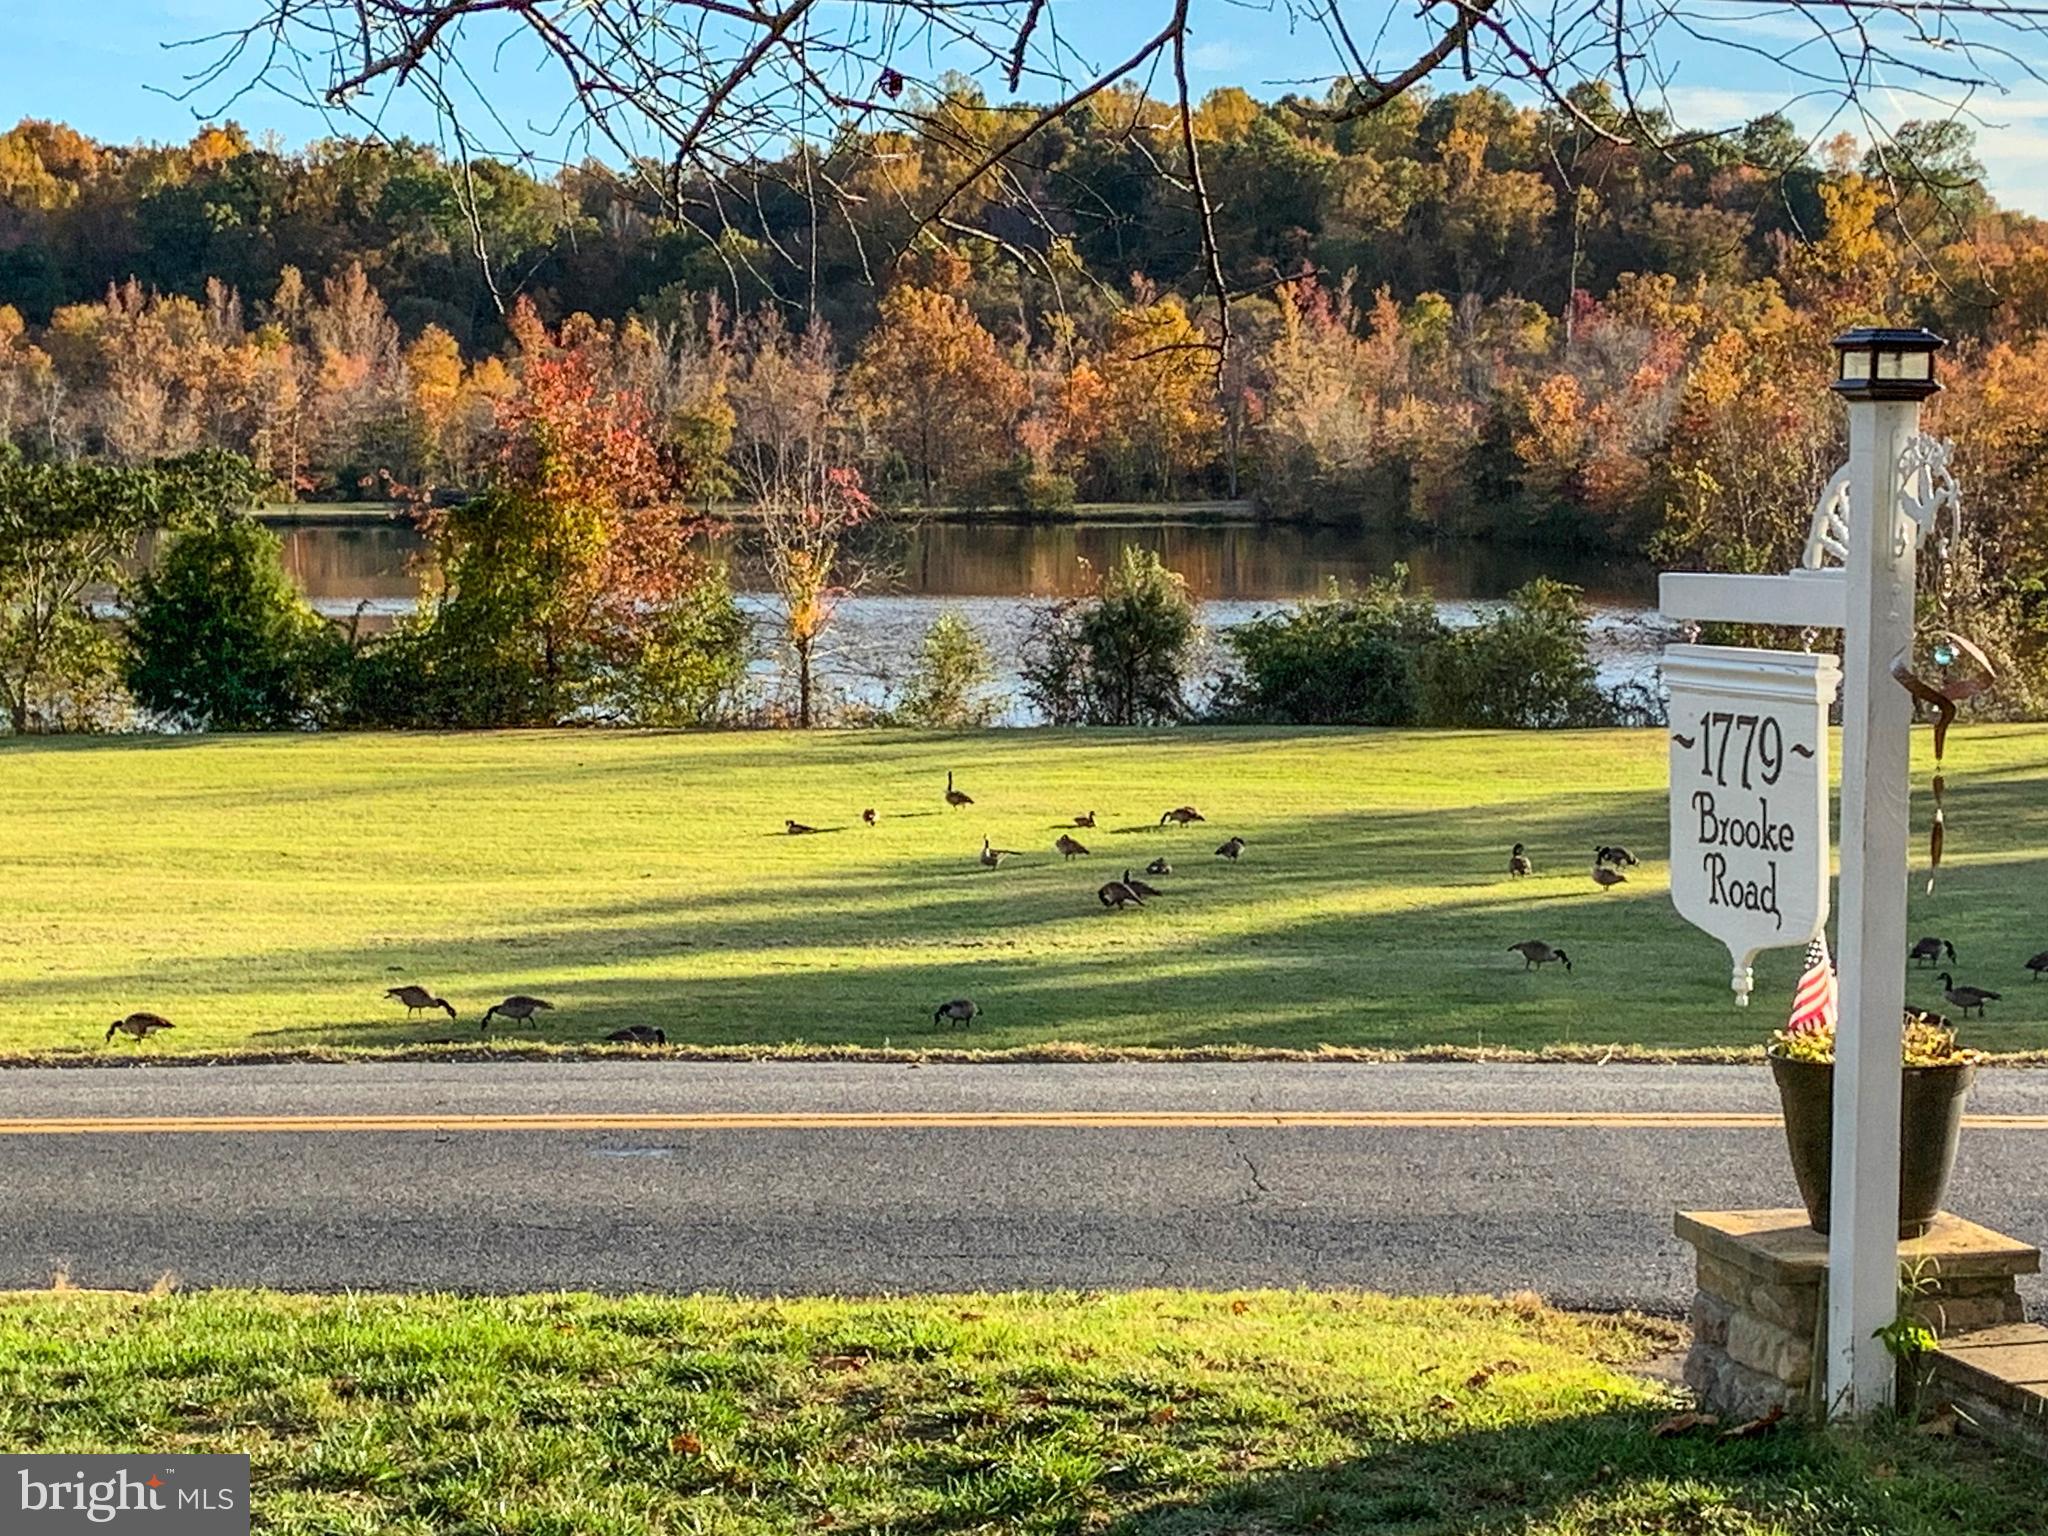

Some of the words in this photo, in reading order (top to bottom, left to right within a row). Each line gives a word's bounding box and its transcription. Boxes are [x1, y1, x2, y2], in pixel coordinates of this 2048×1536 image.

[1700, 711, 1783, 790] 1779
[1692, 791, 1794, 852] Brooke
[1703, 852, 1782, 930] Road
